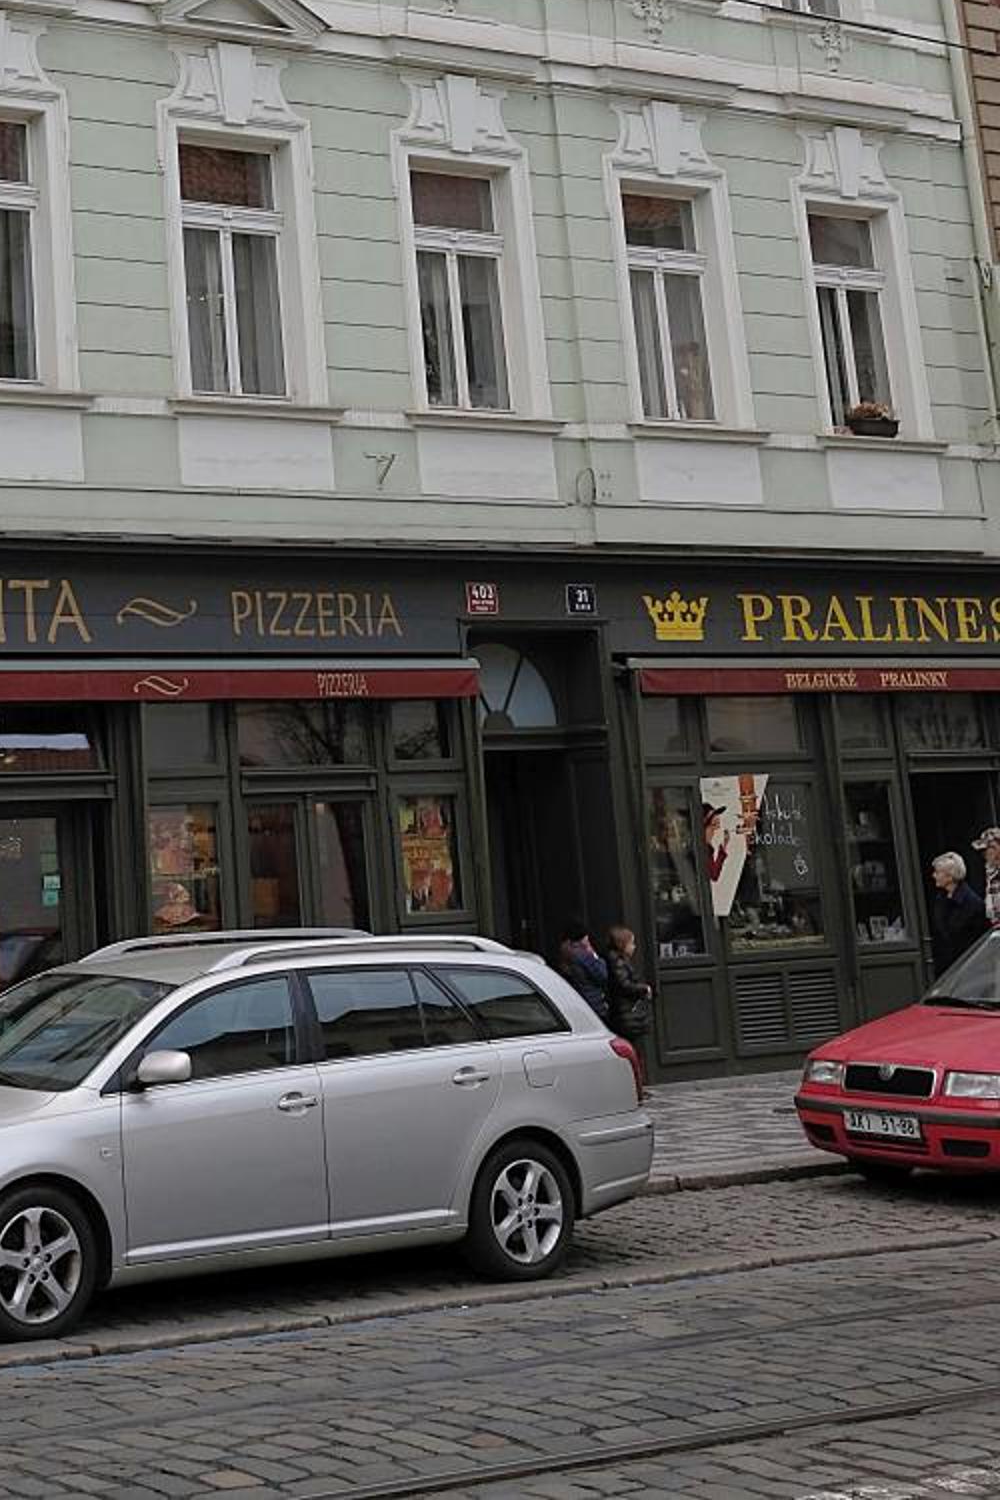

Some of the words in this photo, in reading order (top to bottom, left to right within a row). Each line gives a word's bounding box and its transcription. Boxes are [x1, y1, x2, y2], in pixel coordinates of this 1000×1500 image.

[231, 590, 404, 637] PIZZERIA
[317, 673, 369, 696] PIZZERIA
[785, 671, 857, 689] BELGICKÉ
[879, 672, 949, 688] PRALINKY
